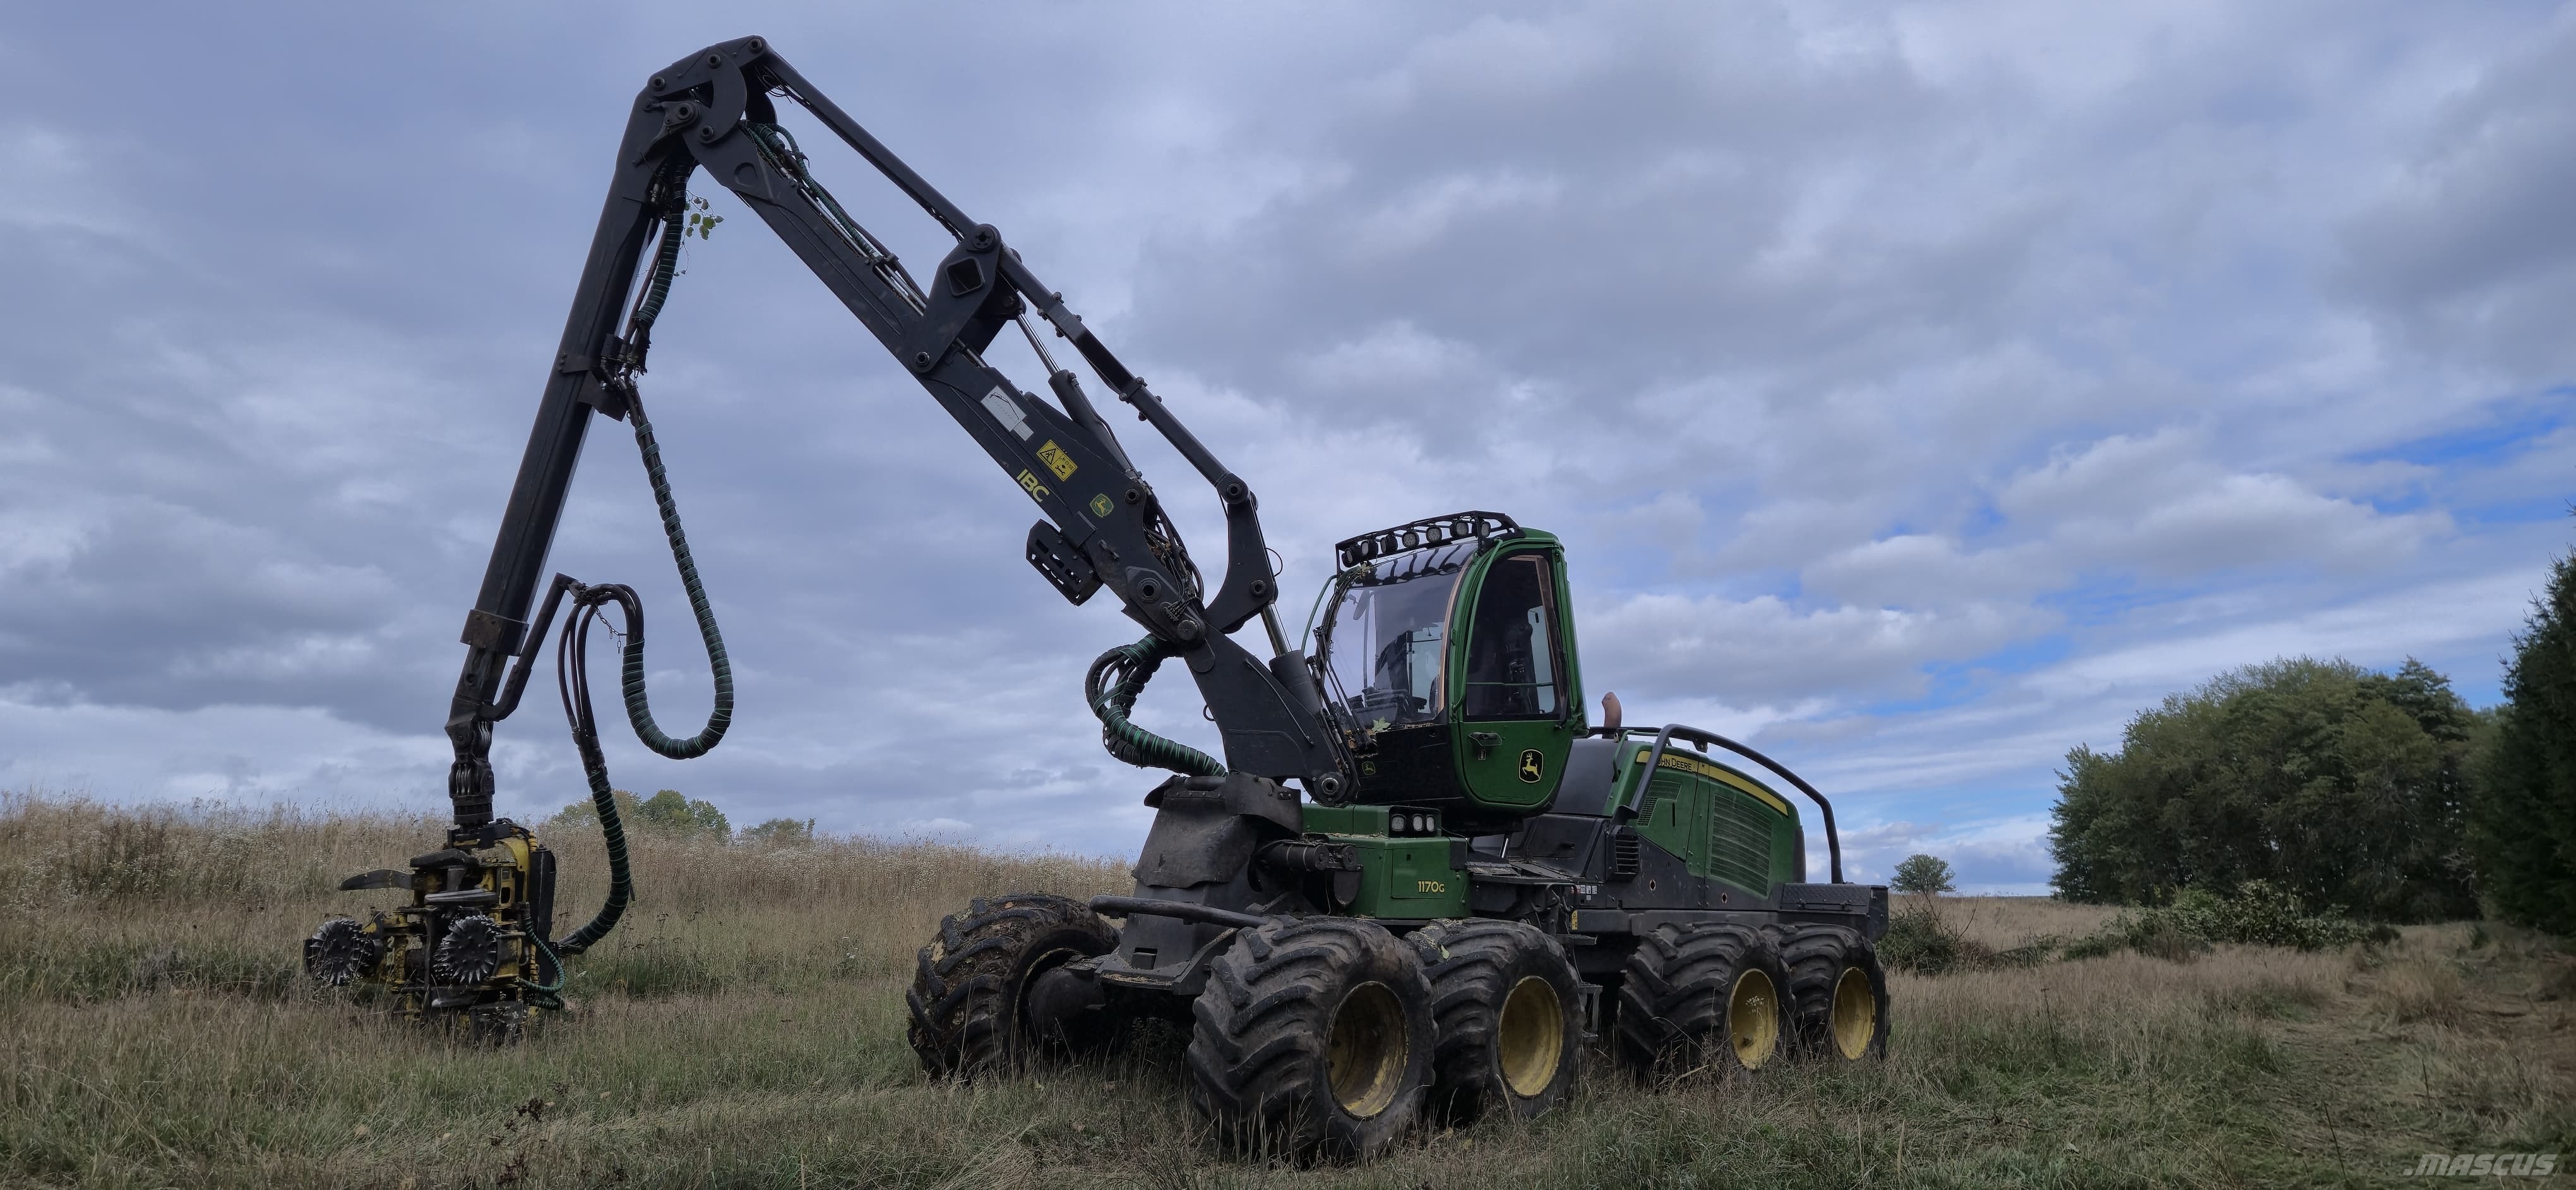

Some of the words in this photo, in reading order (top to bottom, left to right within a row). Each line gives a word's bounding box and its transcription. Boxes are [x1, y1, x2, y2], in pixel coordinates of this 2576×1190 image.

[1017, 469, 1050, 503] IBC
[1671, 758, 1692, 771] DEERE
[1418, 880, 1445, 892] 1170G
